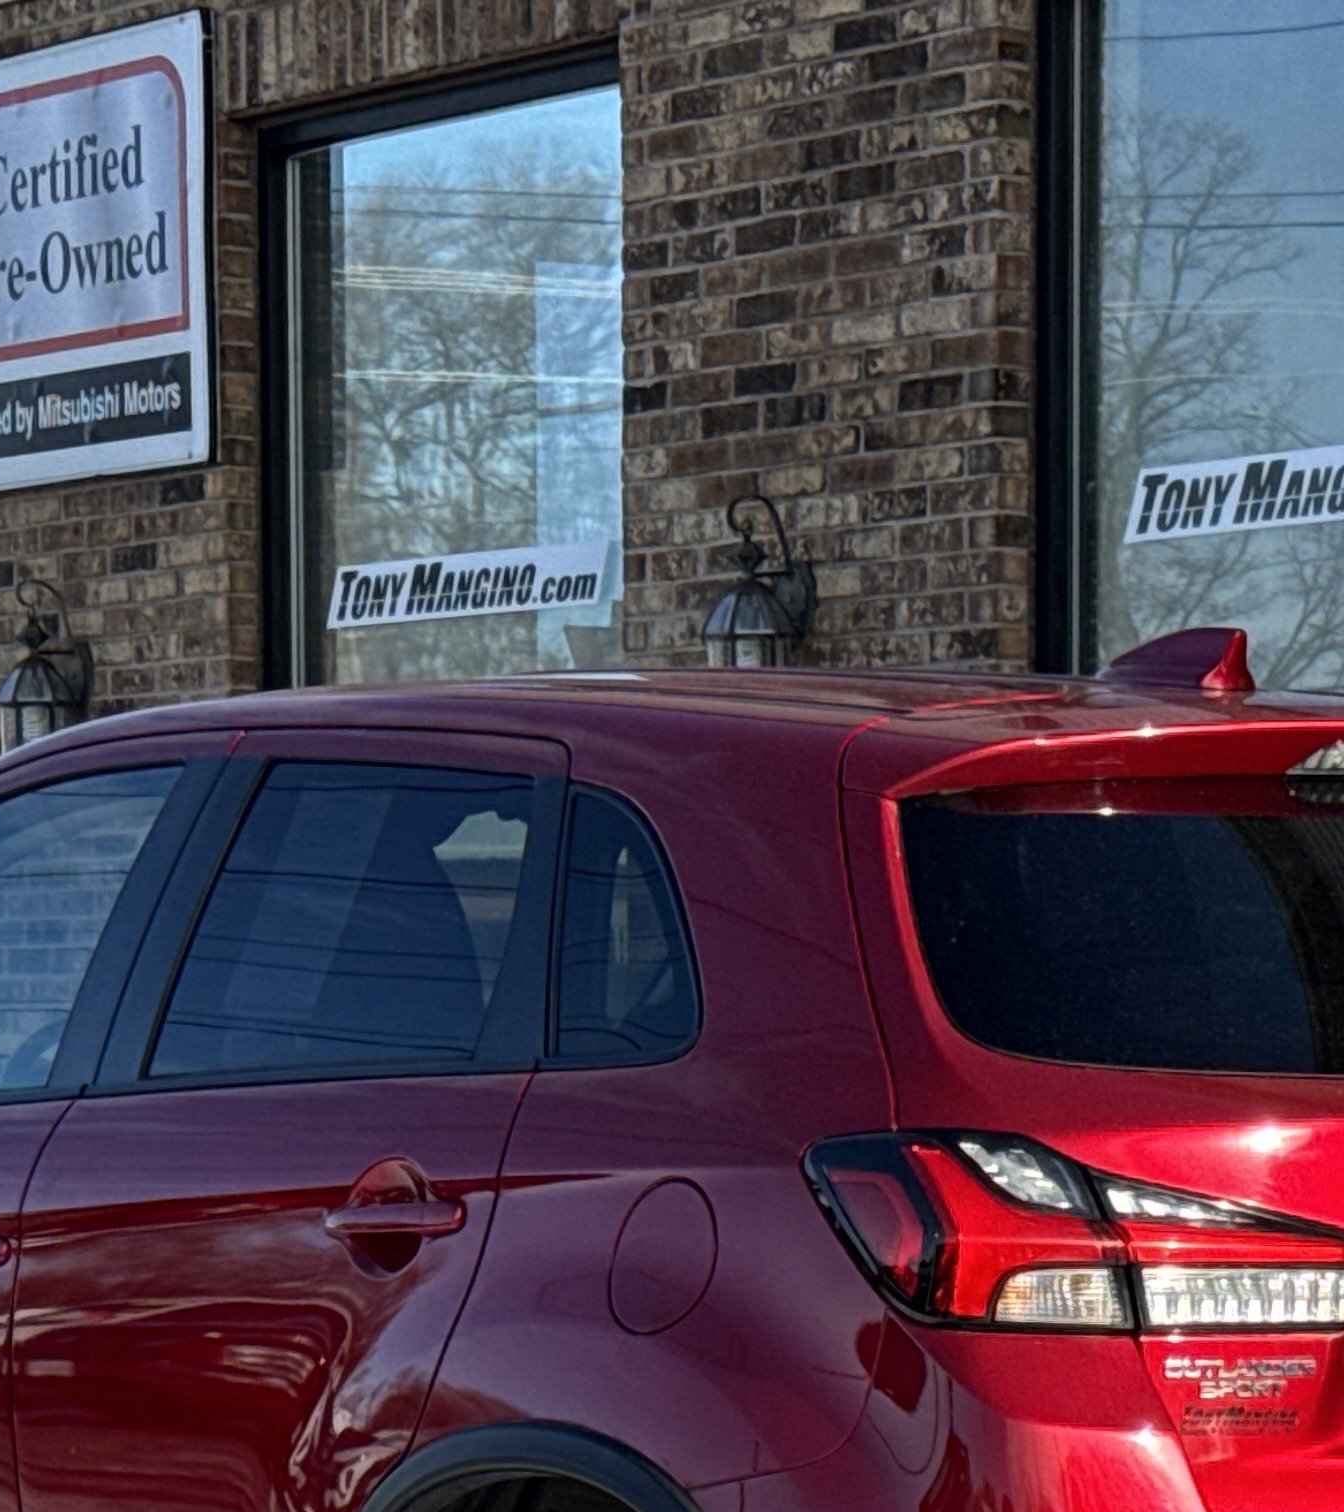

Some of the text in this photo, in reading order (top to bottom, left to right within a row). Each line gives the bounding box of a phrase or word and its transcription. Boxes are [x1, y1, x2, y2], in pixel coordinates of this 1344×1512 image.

[16, 400, 34, 441] by
[38, 384, 119, 429] Mitsubishi
[124, 380, 181, 416] Motors
